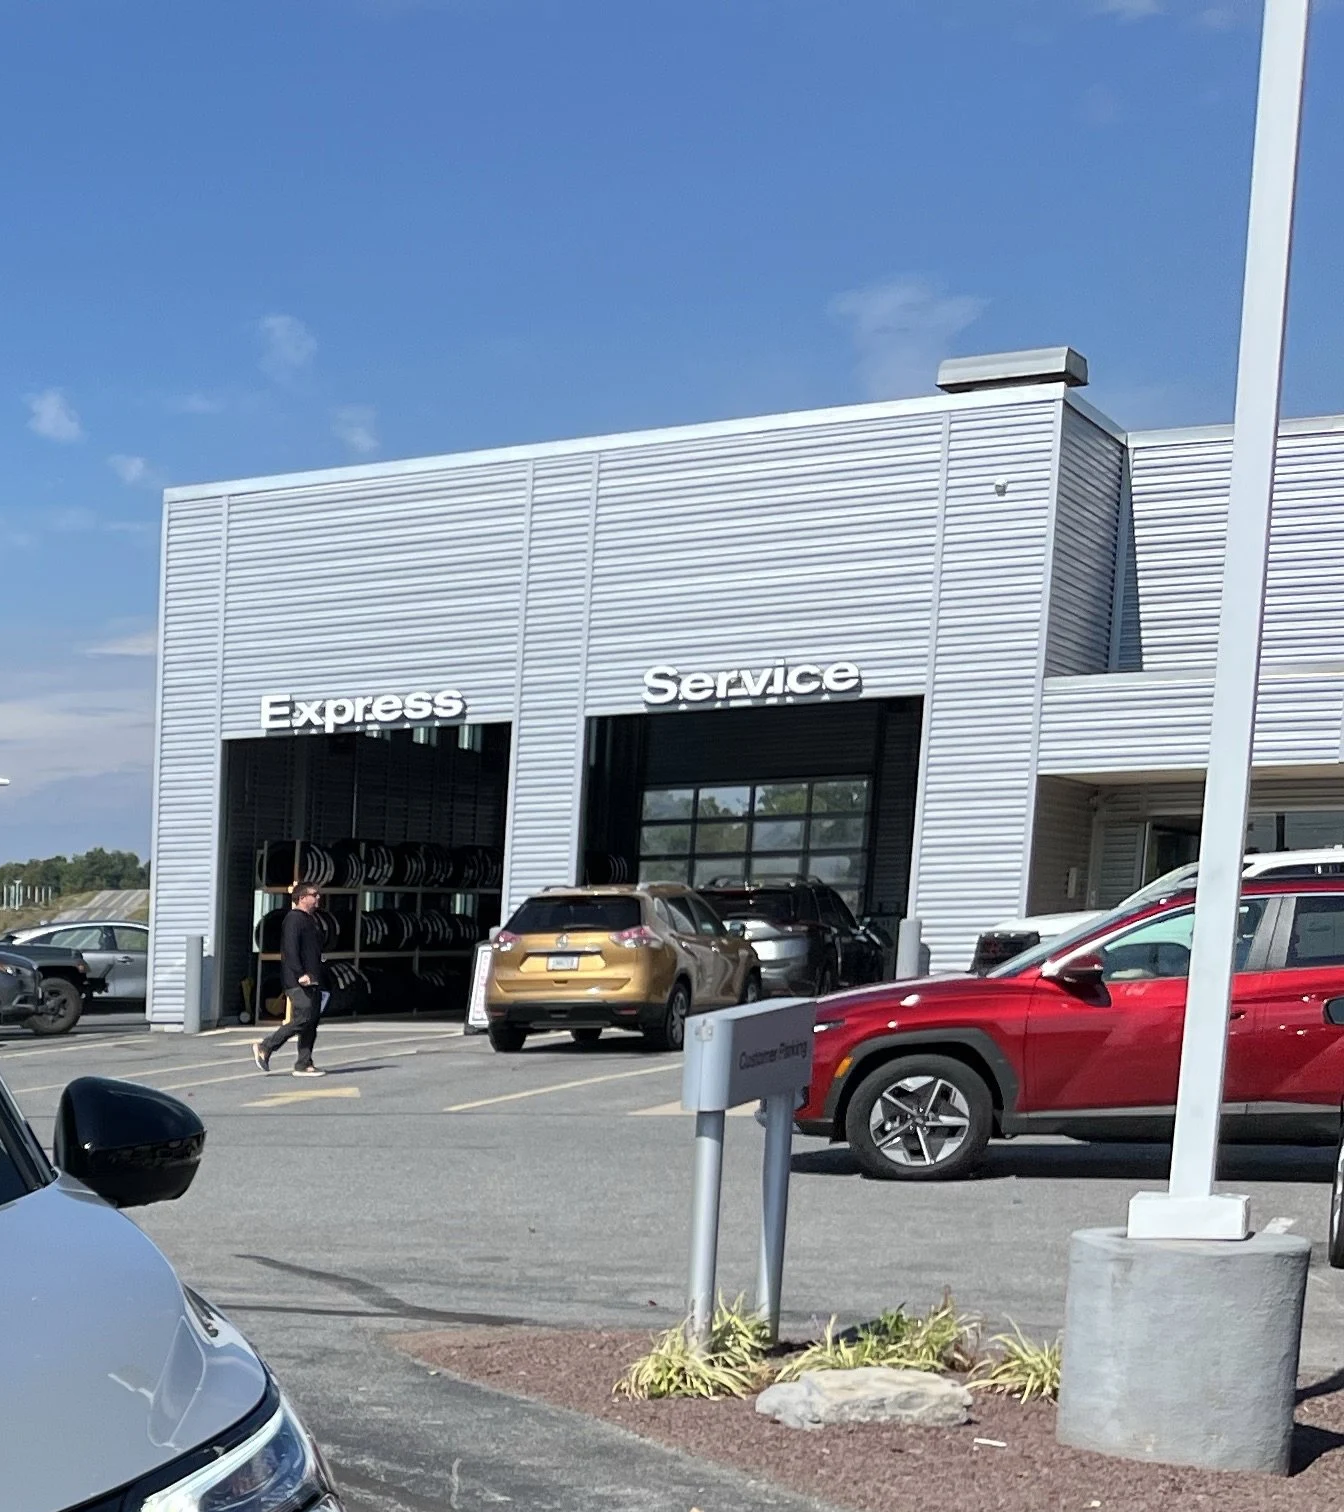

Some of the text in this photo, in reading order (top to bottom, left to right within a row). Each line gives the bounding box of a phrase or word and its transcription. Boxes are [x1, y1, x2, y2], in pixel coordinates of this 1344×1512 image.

[642, 659, 860, 704] Service
[262, 689, 463, 733] Express
[739, 1047, 778, 1070] Customer
